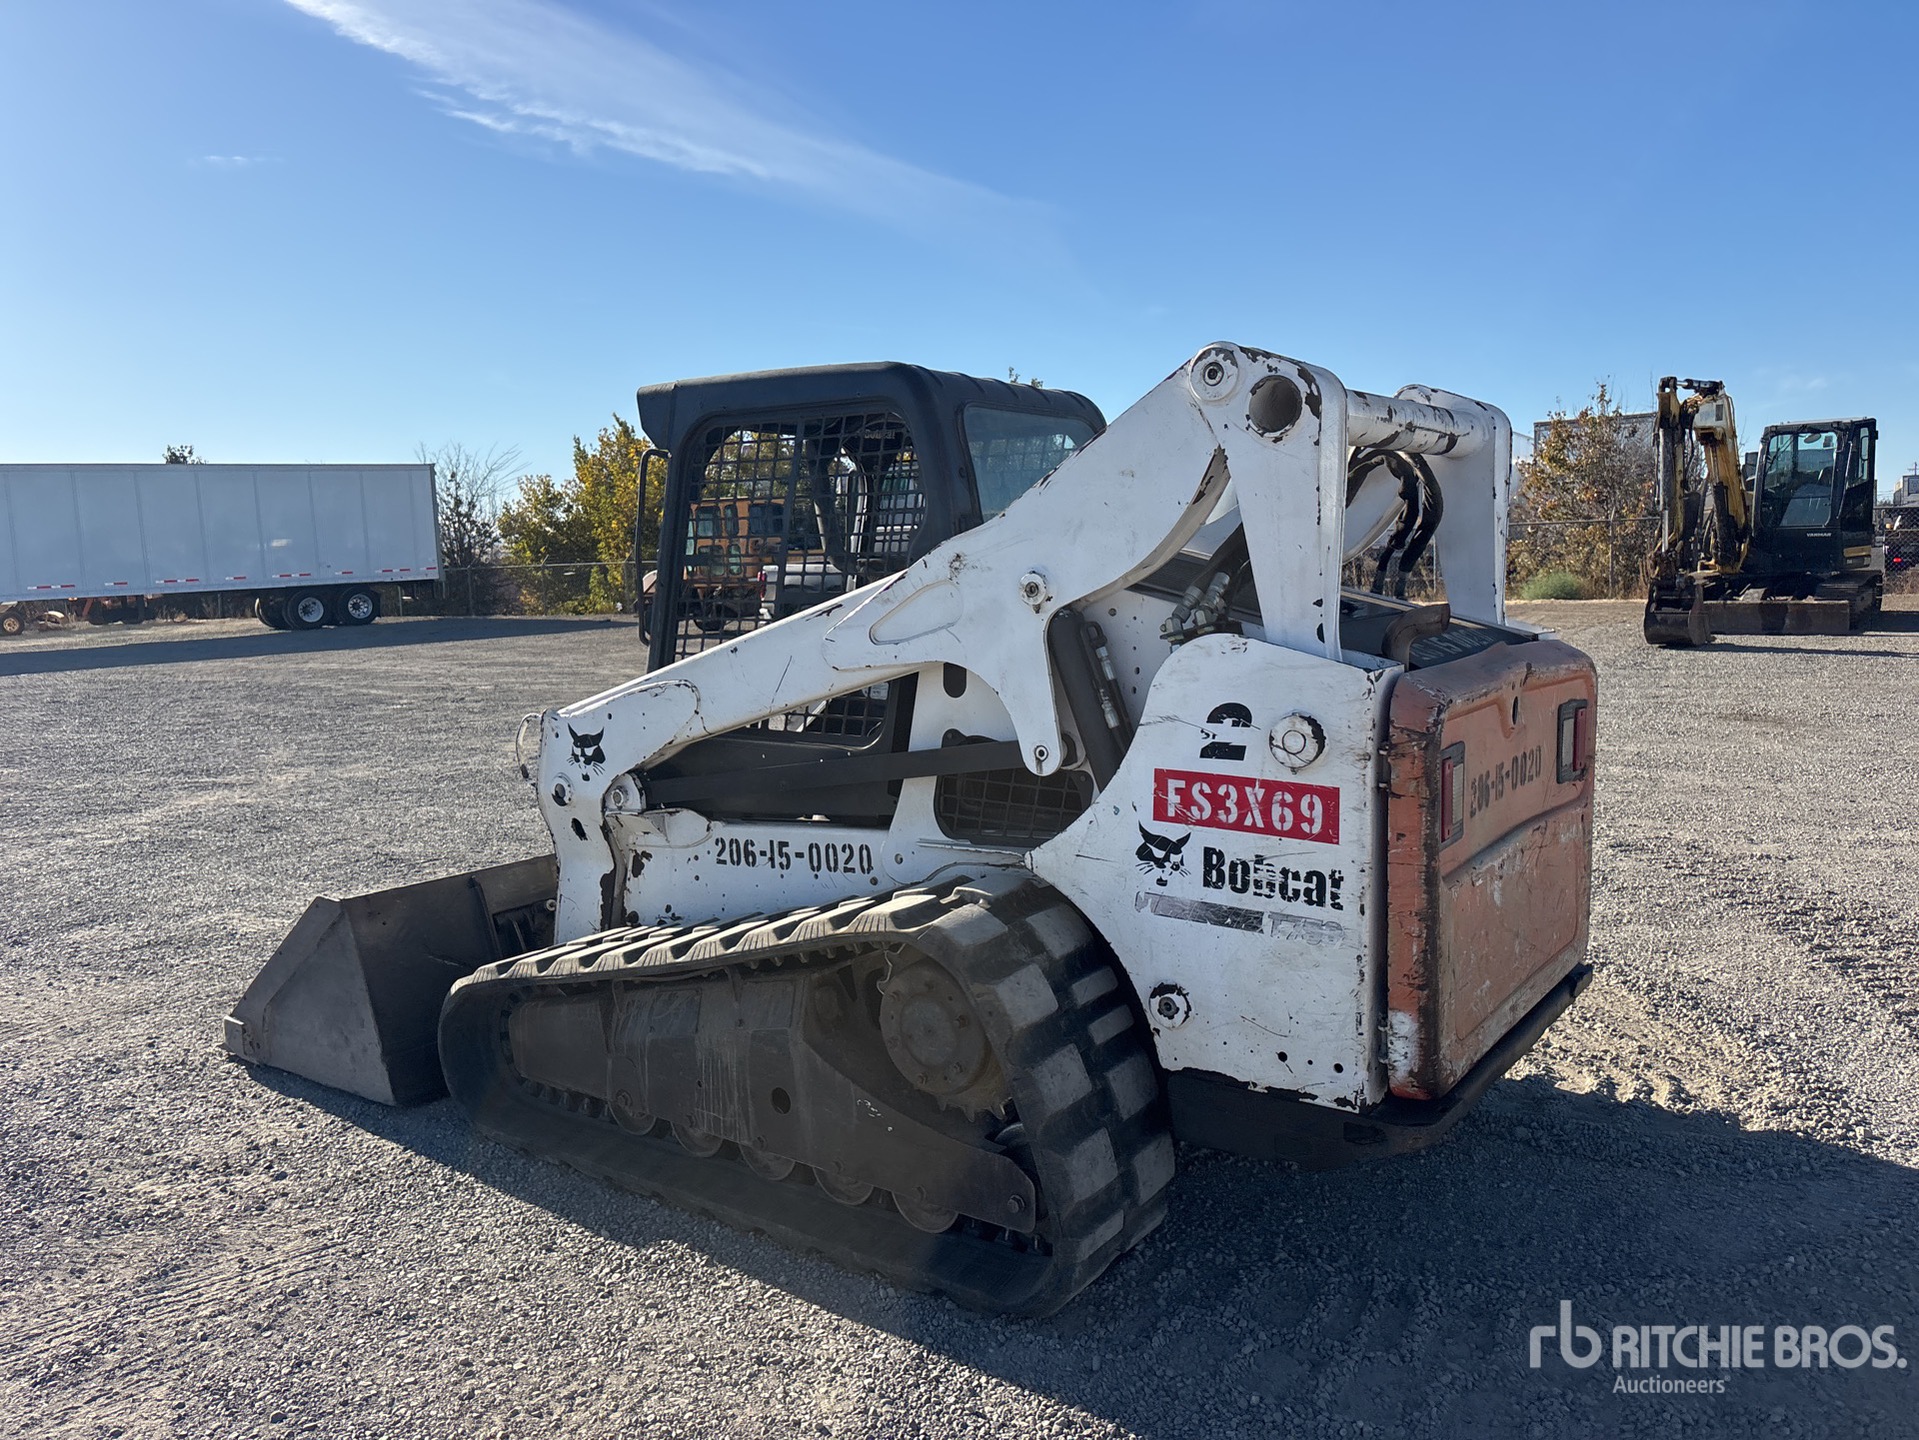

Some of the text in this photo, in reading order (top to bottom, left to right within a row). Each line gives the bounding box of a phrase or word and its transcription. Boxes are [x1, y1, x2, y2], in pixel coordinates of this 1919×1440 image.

[1167, 779, 1323, 834] FS3X69
[1470, 745, 1542, 818] 206-15-0020
[715, 837, 874, 875] 206-15-0020
[1203, 846, 1344, 910] Bobcat
